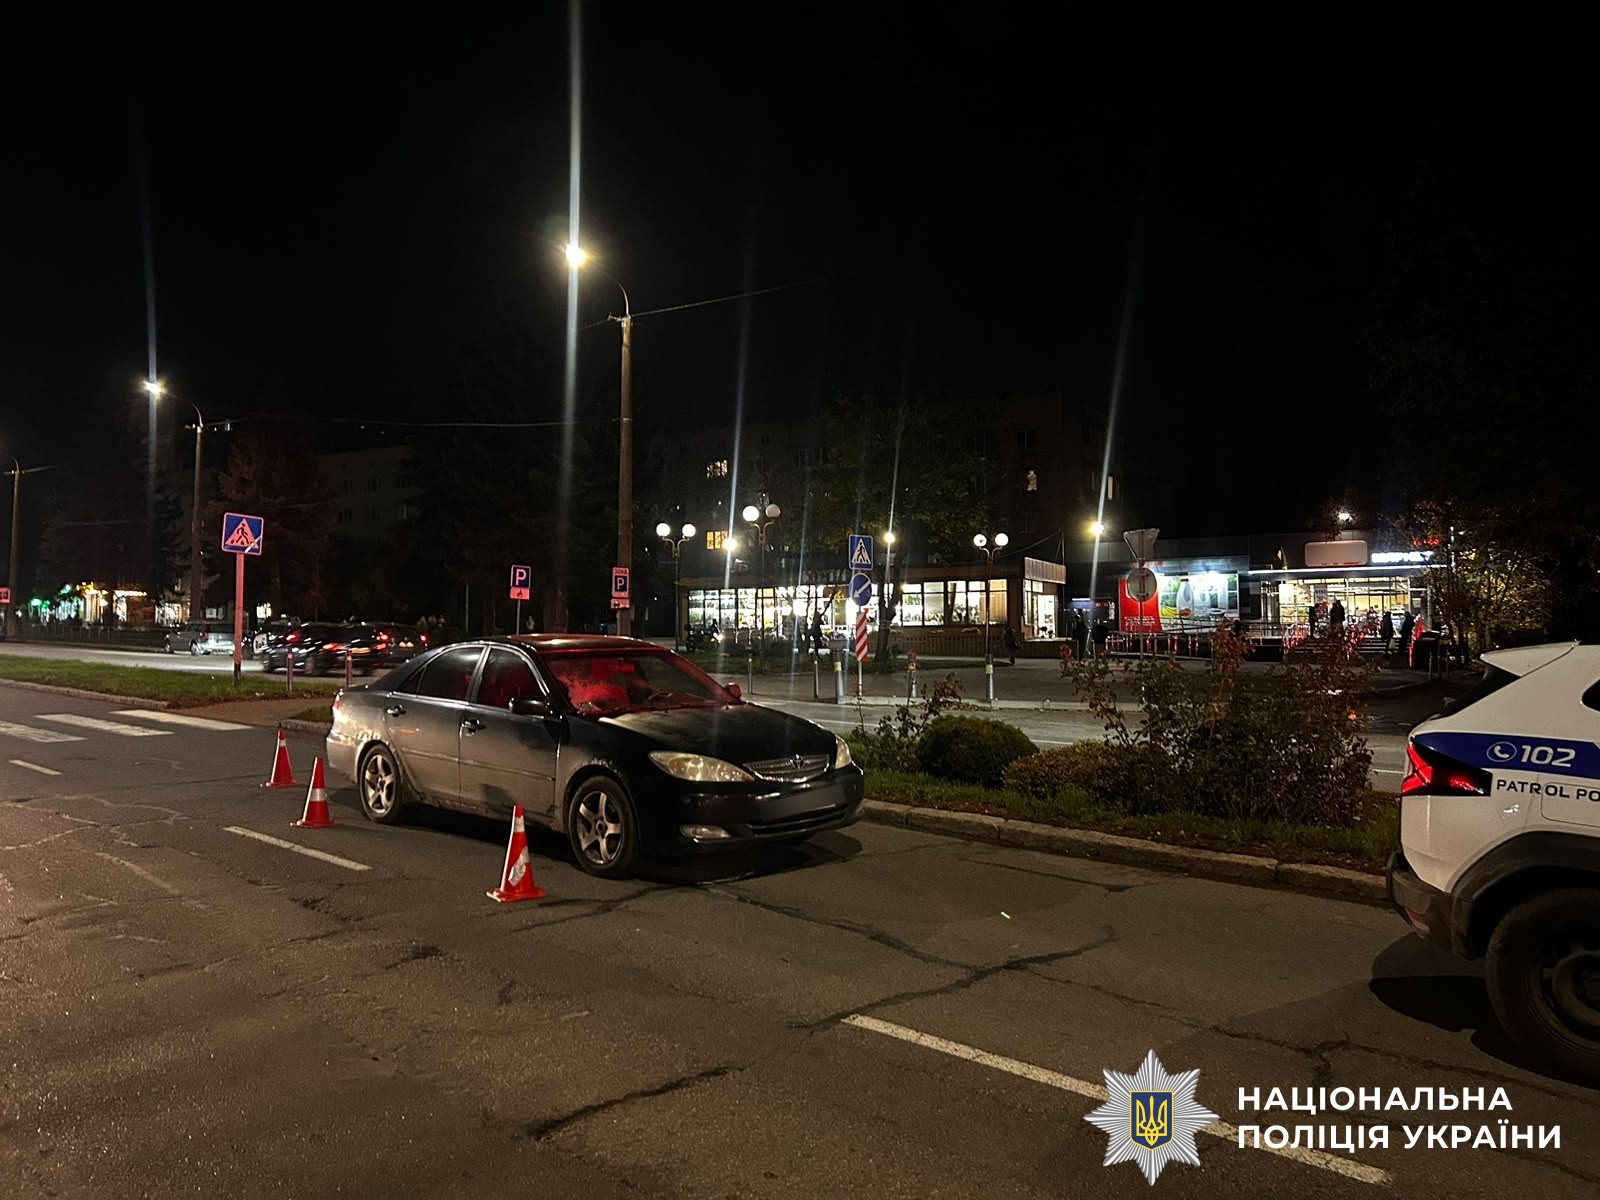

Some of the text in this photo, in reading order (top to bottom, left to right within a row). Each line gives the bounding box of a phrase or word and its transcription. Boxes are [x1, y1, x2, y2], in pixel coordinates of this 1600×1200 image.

[516, 569, 526, 586] P
[616, 577, 625, 590] P
[1521, 745, 1575, 767] 102
[1496, 779, 1570, 798] PATROL
